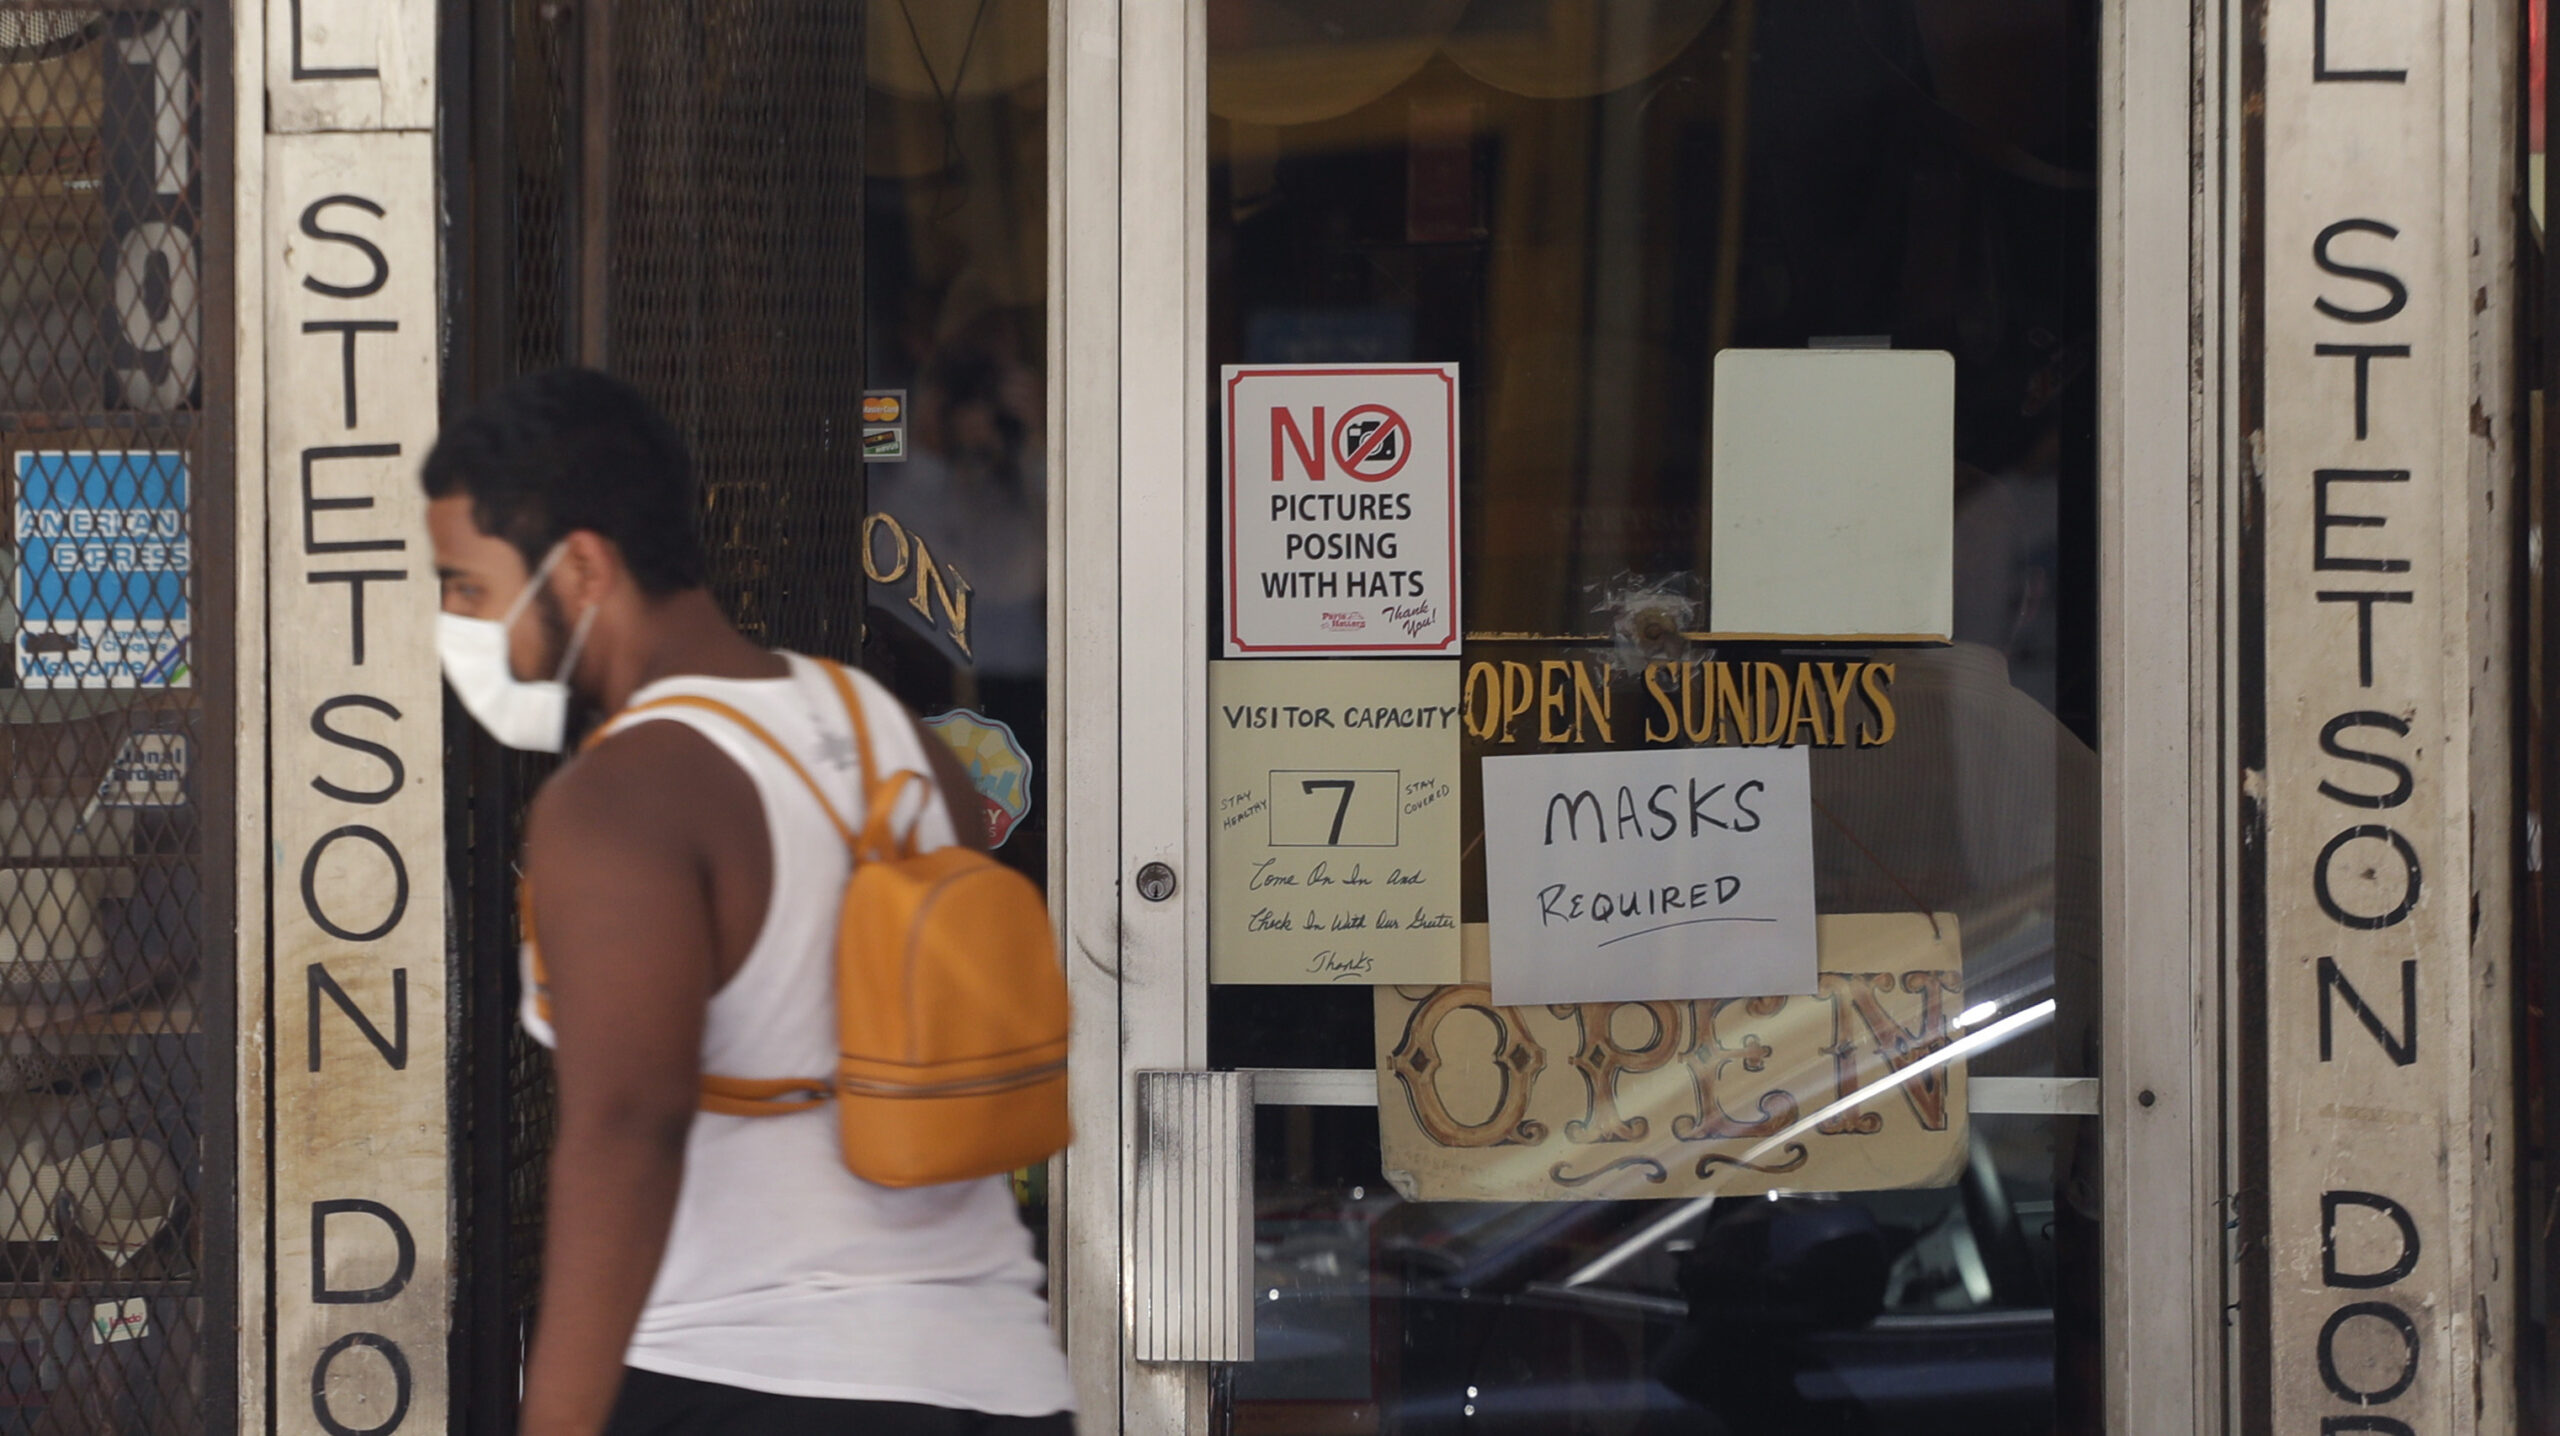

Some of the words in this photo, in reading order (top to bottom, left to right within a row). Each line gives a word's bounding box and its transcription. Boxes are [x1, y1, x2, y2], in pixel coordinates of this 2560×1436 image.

[1271, 404, 1411, 482] NO
[1271, 493, 1412, 521] PICTURES
[1286, 532, 1397, 560] POSING
[1261, 572, 1337, 598] WITH
[1347, 570, 1424, 598] HATS
[1381, 599, 1429, 623] Thank
[1402, 607, 1437, 638] You!
[299, 194, 410, 1073] STETSON
[2313, 218, 2422, 1067] STETSON
[1223, 705, 1335, 729] VISITOR
[1344, 706, 1456, 729] CAPACITY
[1463, 660, 1615, 744] OPEN
[1645, 660, 1897, 746] SUNDAYS
[1220, 789, 1251, 811] STAY
[1404, 783, 1450, 815] COVERED
[1405, 777, 1435, 796] STAY
[1223, 798, 1267, 831] HEALTHY
[1302, 780, 1355, 845] 7
[1544, 778, 1764, 845] MASKS
[1250, 857, 1299, 891] Come
[1307, 861, 1334, 886] On
[1342, 863, 1372, 886] In
[1537, 875, 1741, 927] REQUIRED
[1248, 907, 1293, 932] Check
[1303, 909, 1325, 931] In
[1330, 910, 1367, 931] With
[1375, 909, 1399, 930] Our
[1306, 950, 1375, 975] Thanks
[1386, 970, 1961, 1147] OPEN
[2316, 1190, 2421, 1436] DO
